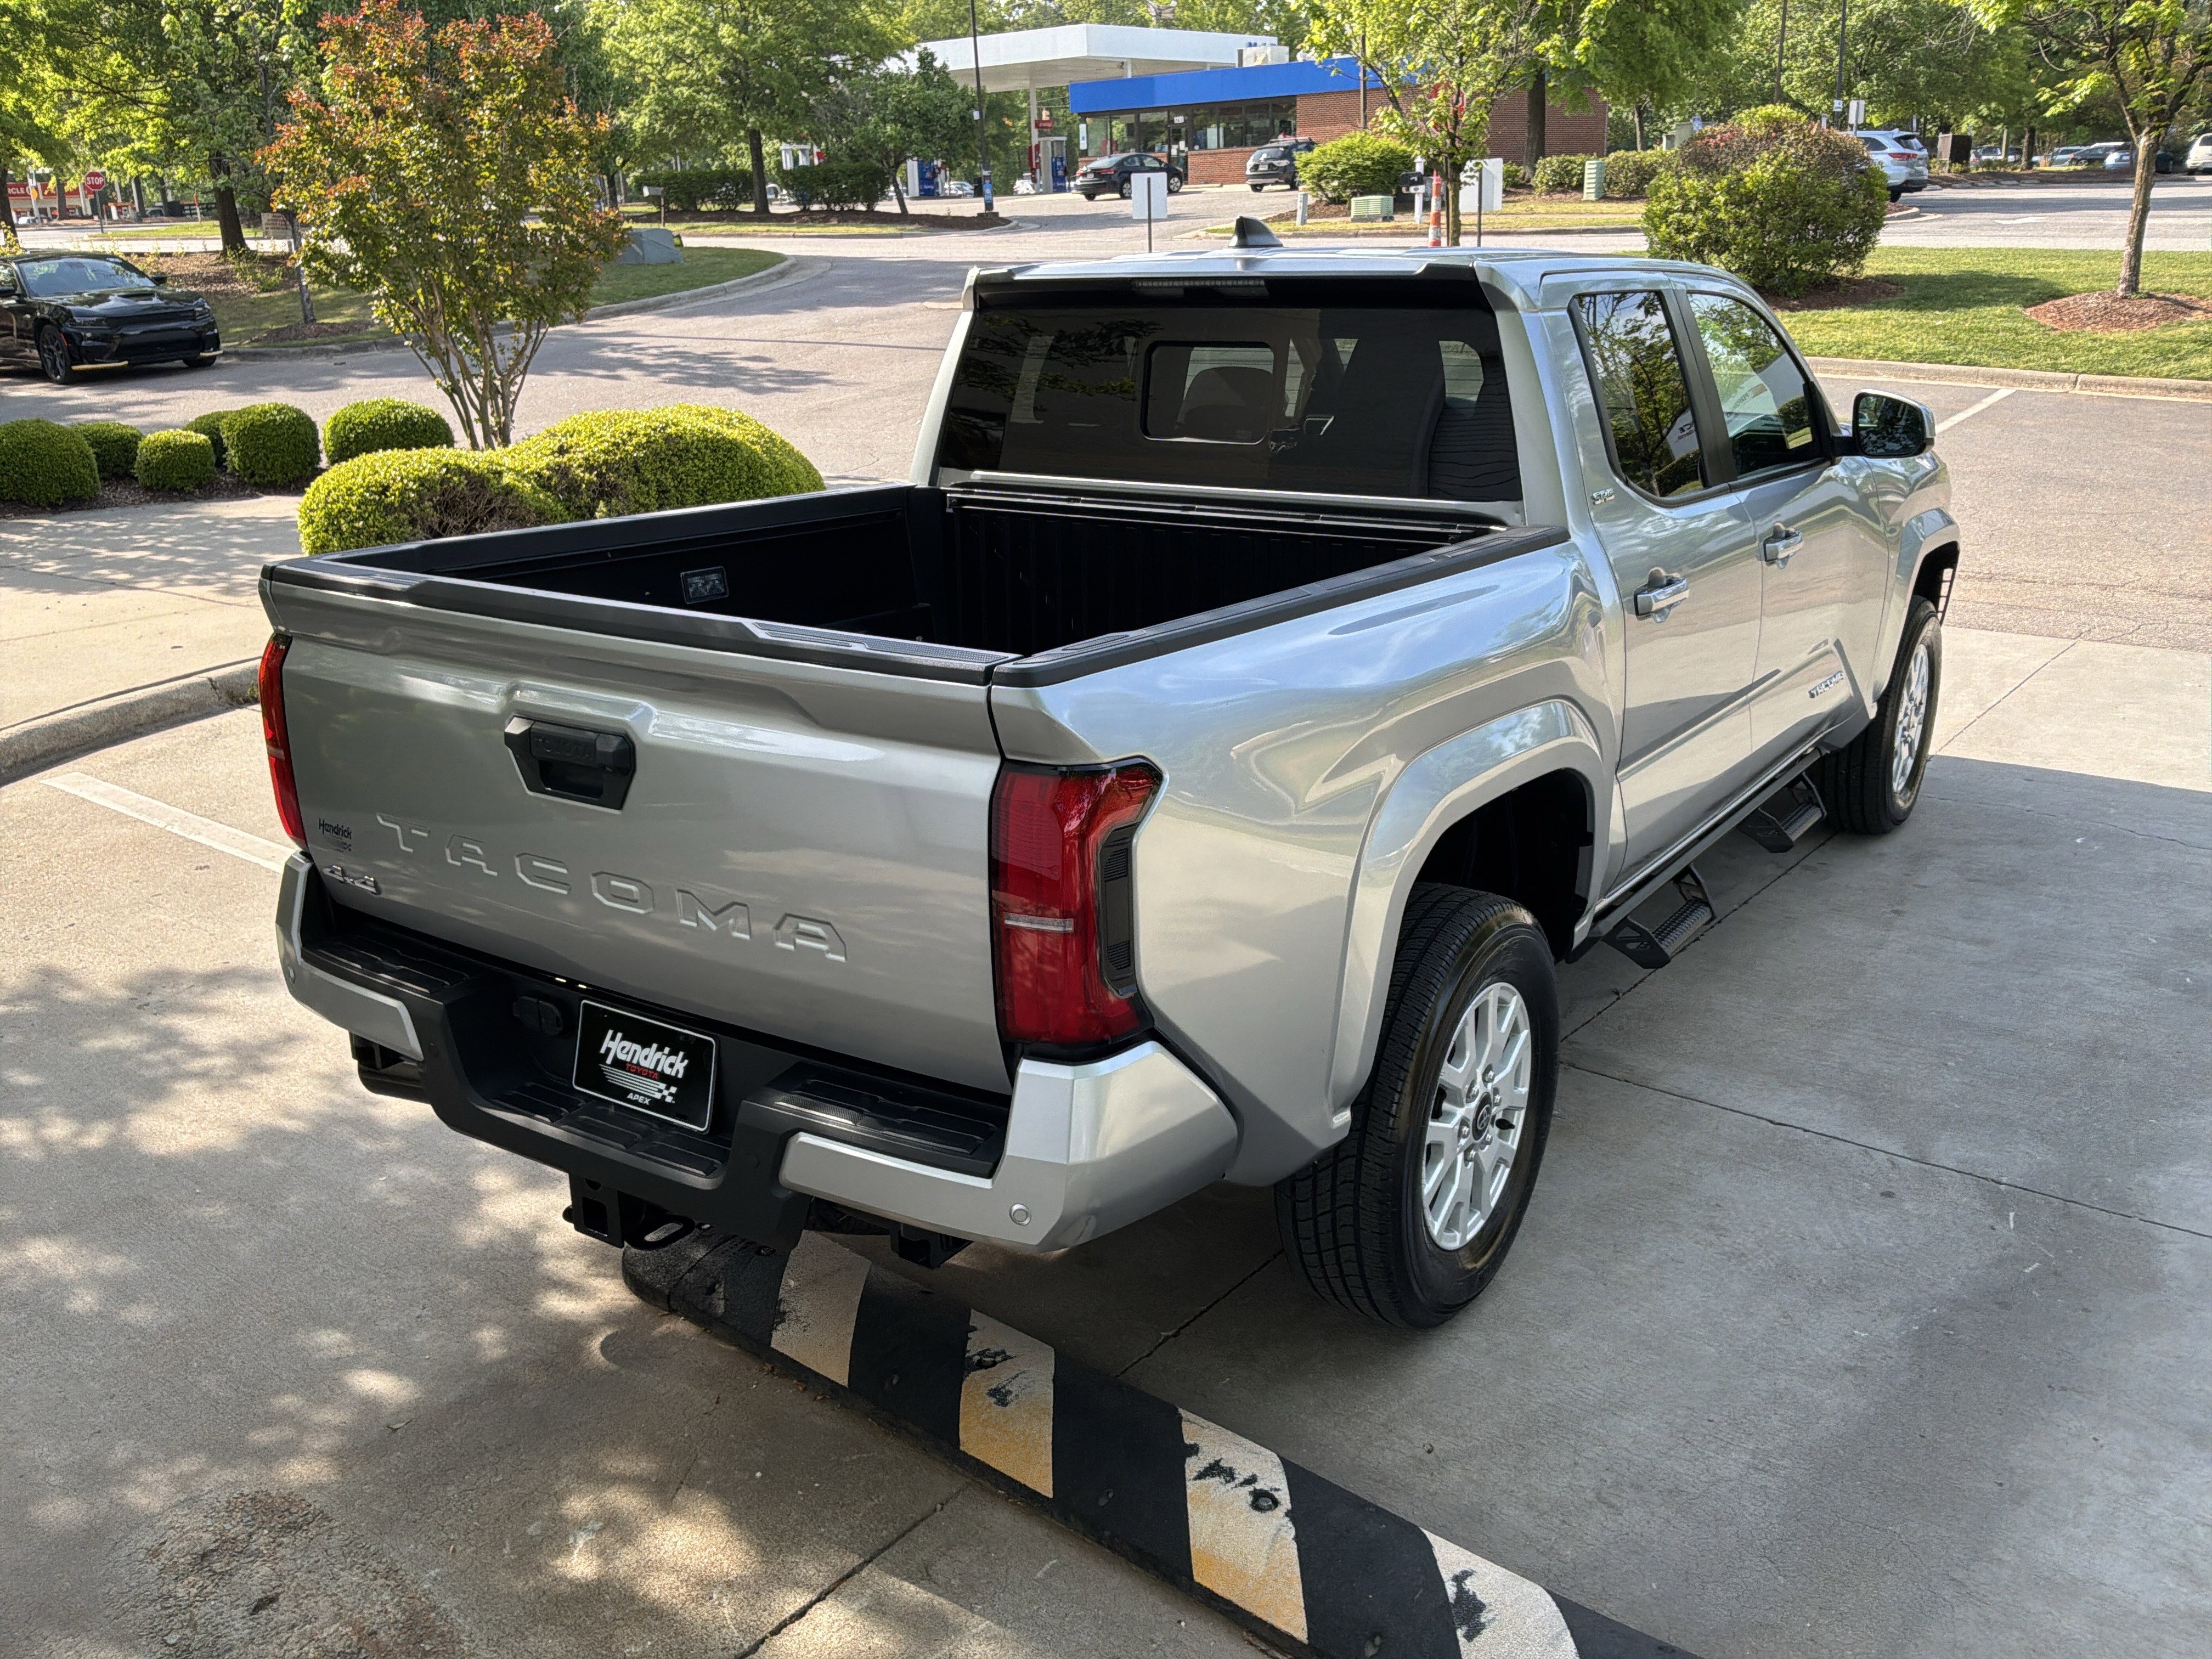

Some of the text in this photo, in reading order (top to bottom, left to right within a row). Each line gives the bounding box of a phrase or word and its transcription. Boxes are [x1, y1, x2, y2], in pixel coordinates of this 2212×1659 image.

[86, 177, 104, 185] STOP
[1592, 488, 1615, 501] SR5
[1808, 671, 1844, 698] TACOMA
[318, 817, 352, 839] Hendrick
[376, 812, 847, 963] TACOMA
[600, 1029, 690, 1079] Hendrick
[625, 1063, 659, 1080] TOYOTA
[626, 1092, 652, 1105] APEX
